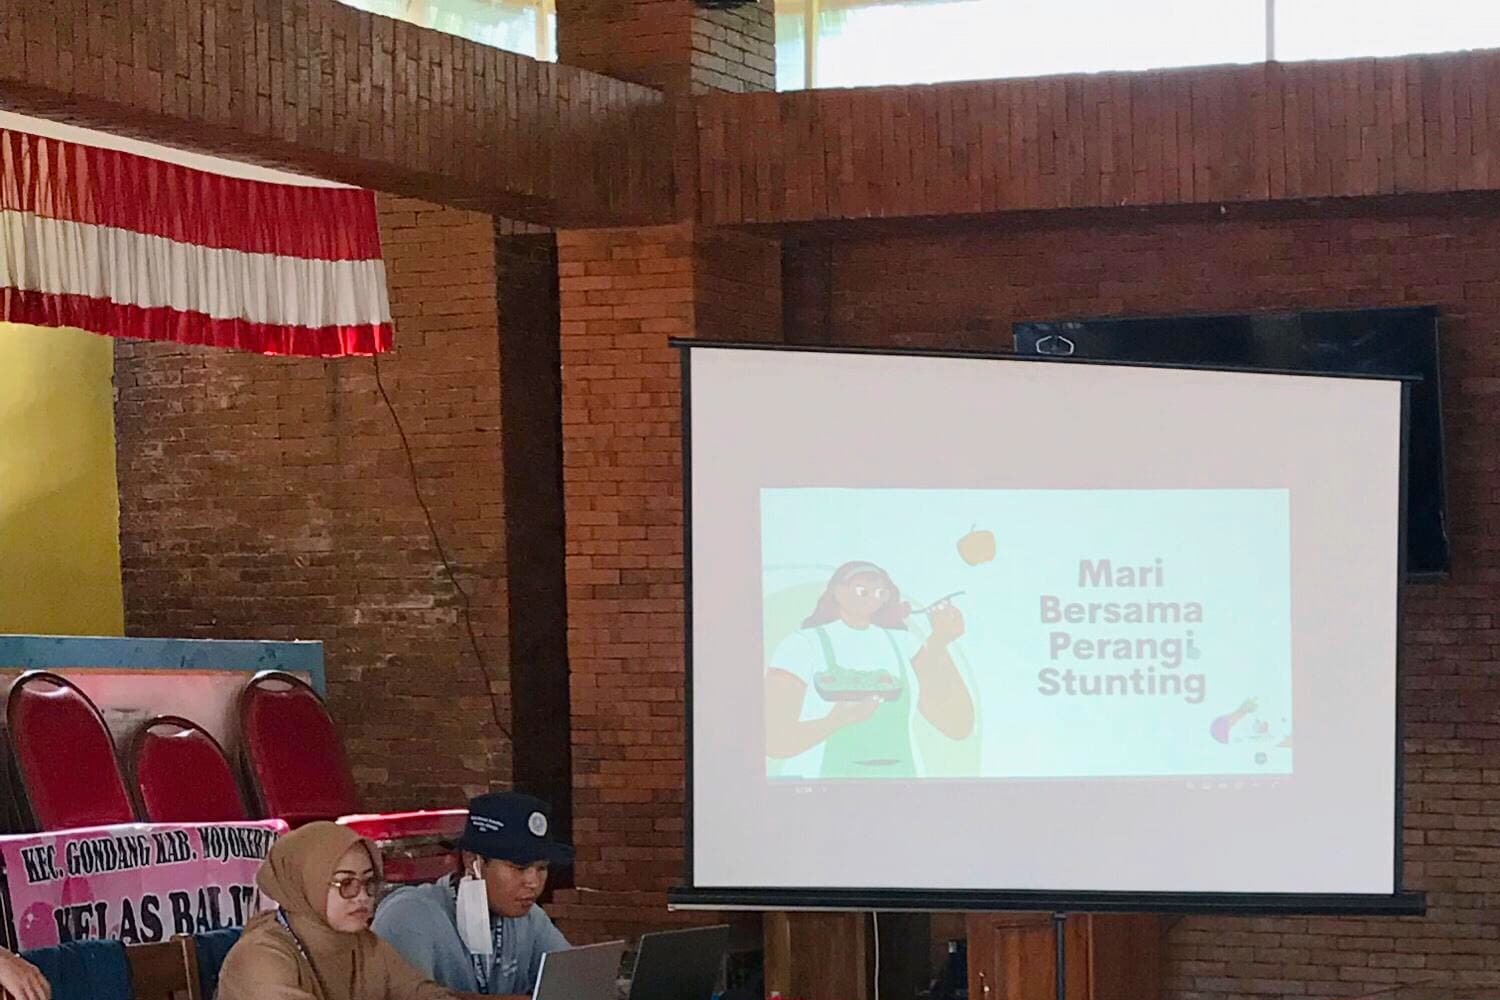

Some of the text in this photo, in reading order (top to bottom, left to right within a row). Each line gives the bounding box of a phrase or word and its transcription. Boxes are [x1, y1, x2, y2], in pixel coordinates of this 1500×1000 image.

[1078, 557, 1164, 588] Mari
[1039, 594, 1203, 624] Bersama
[1049, 629, 1196, 669] Perangi
[1037, 666, 1206, 704] Stunting
[22, 845, 64, 883] KEC.
[67, 834, 150, 874] GONDANG
[152, 830, 197, 864] KAB.
[54, 894, 163, 944] KELAS
